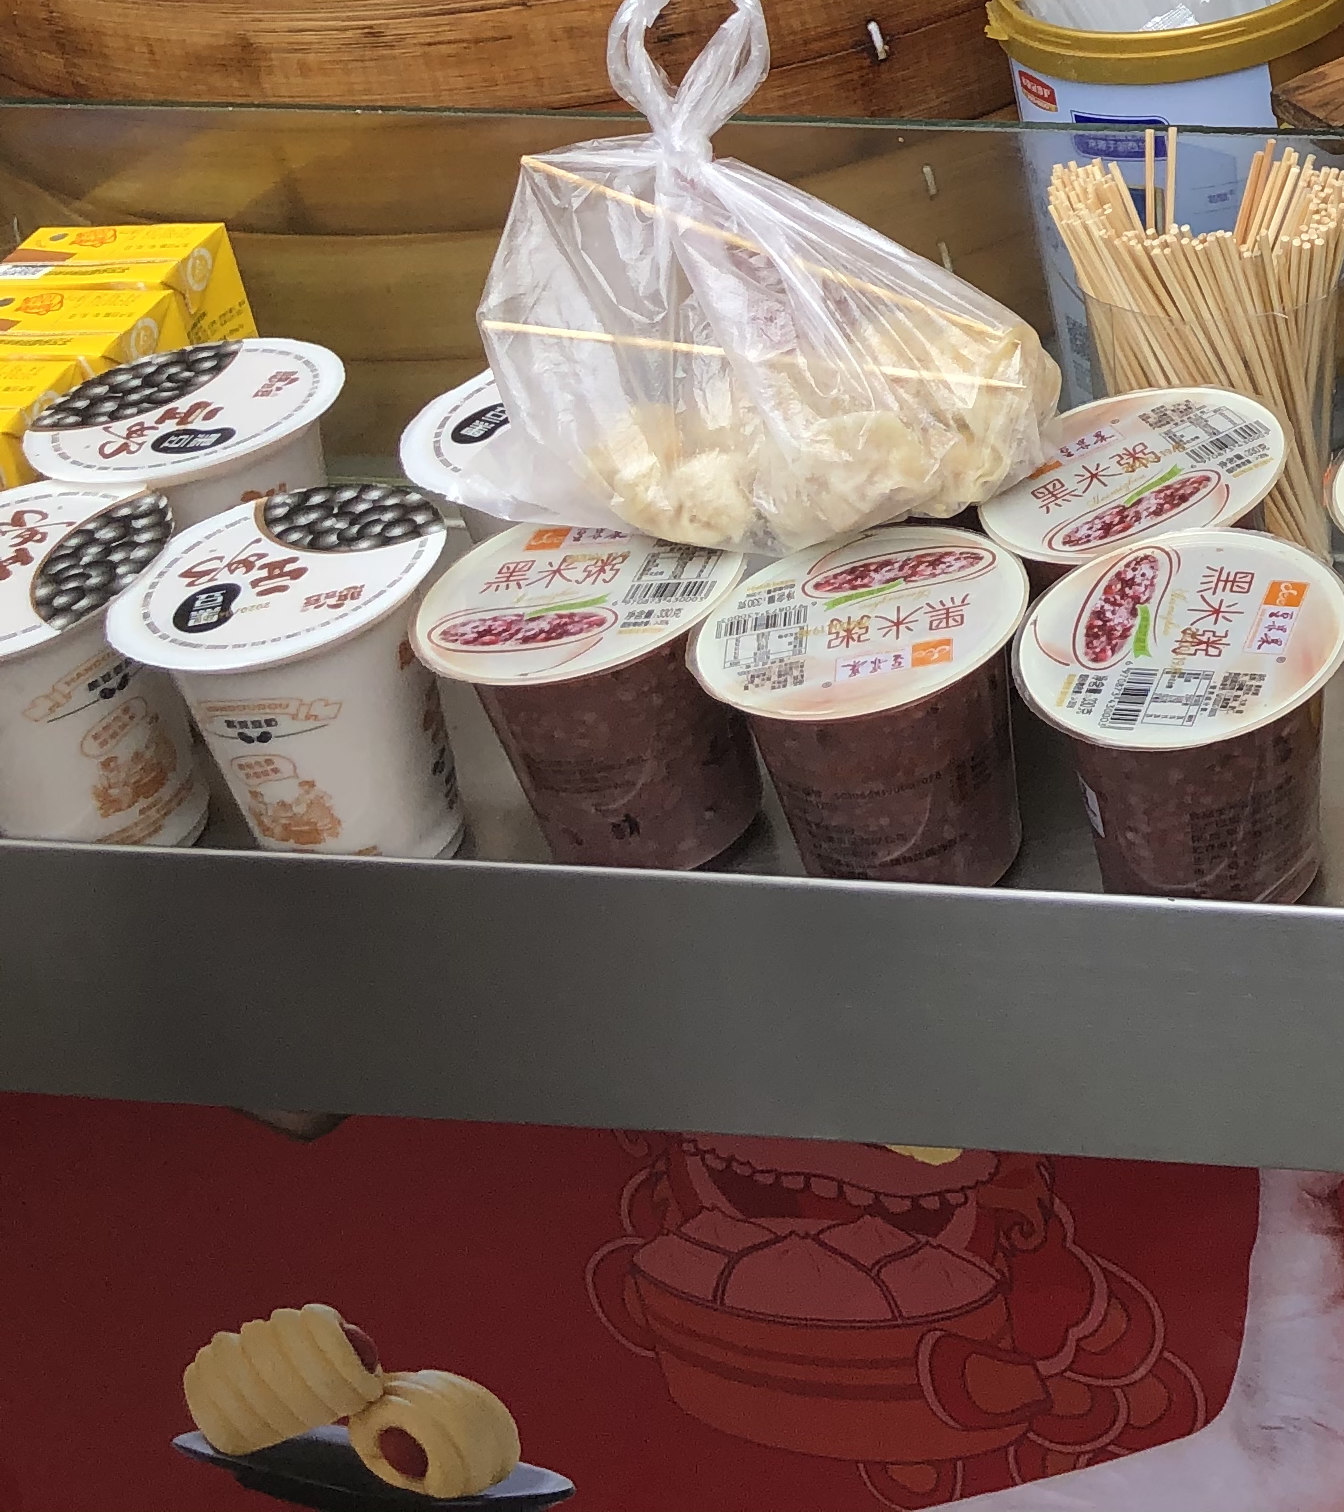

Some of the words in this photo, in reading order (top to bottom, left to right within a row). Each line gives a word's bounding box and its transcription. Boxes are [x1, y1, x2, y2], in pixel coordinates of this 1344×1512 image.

[1030, 441, 1161, 514] 黑米粥
[479, 551, 631, 594] 黑米粥
[826, 592, 971, 650] 黑米粥
[1171, 564, 1255, 660] 黑米粥
